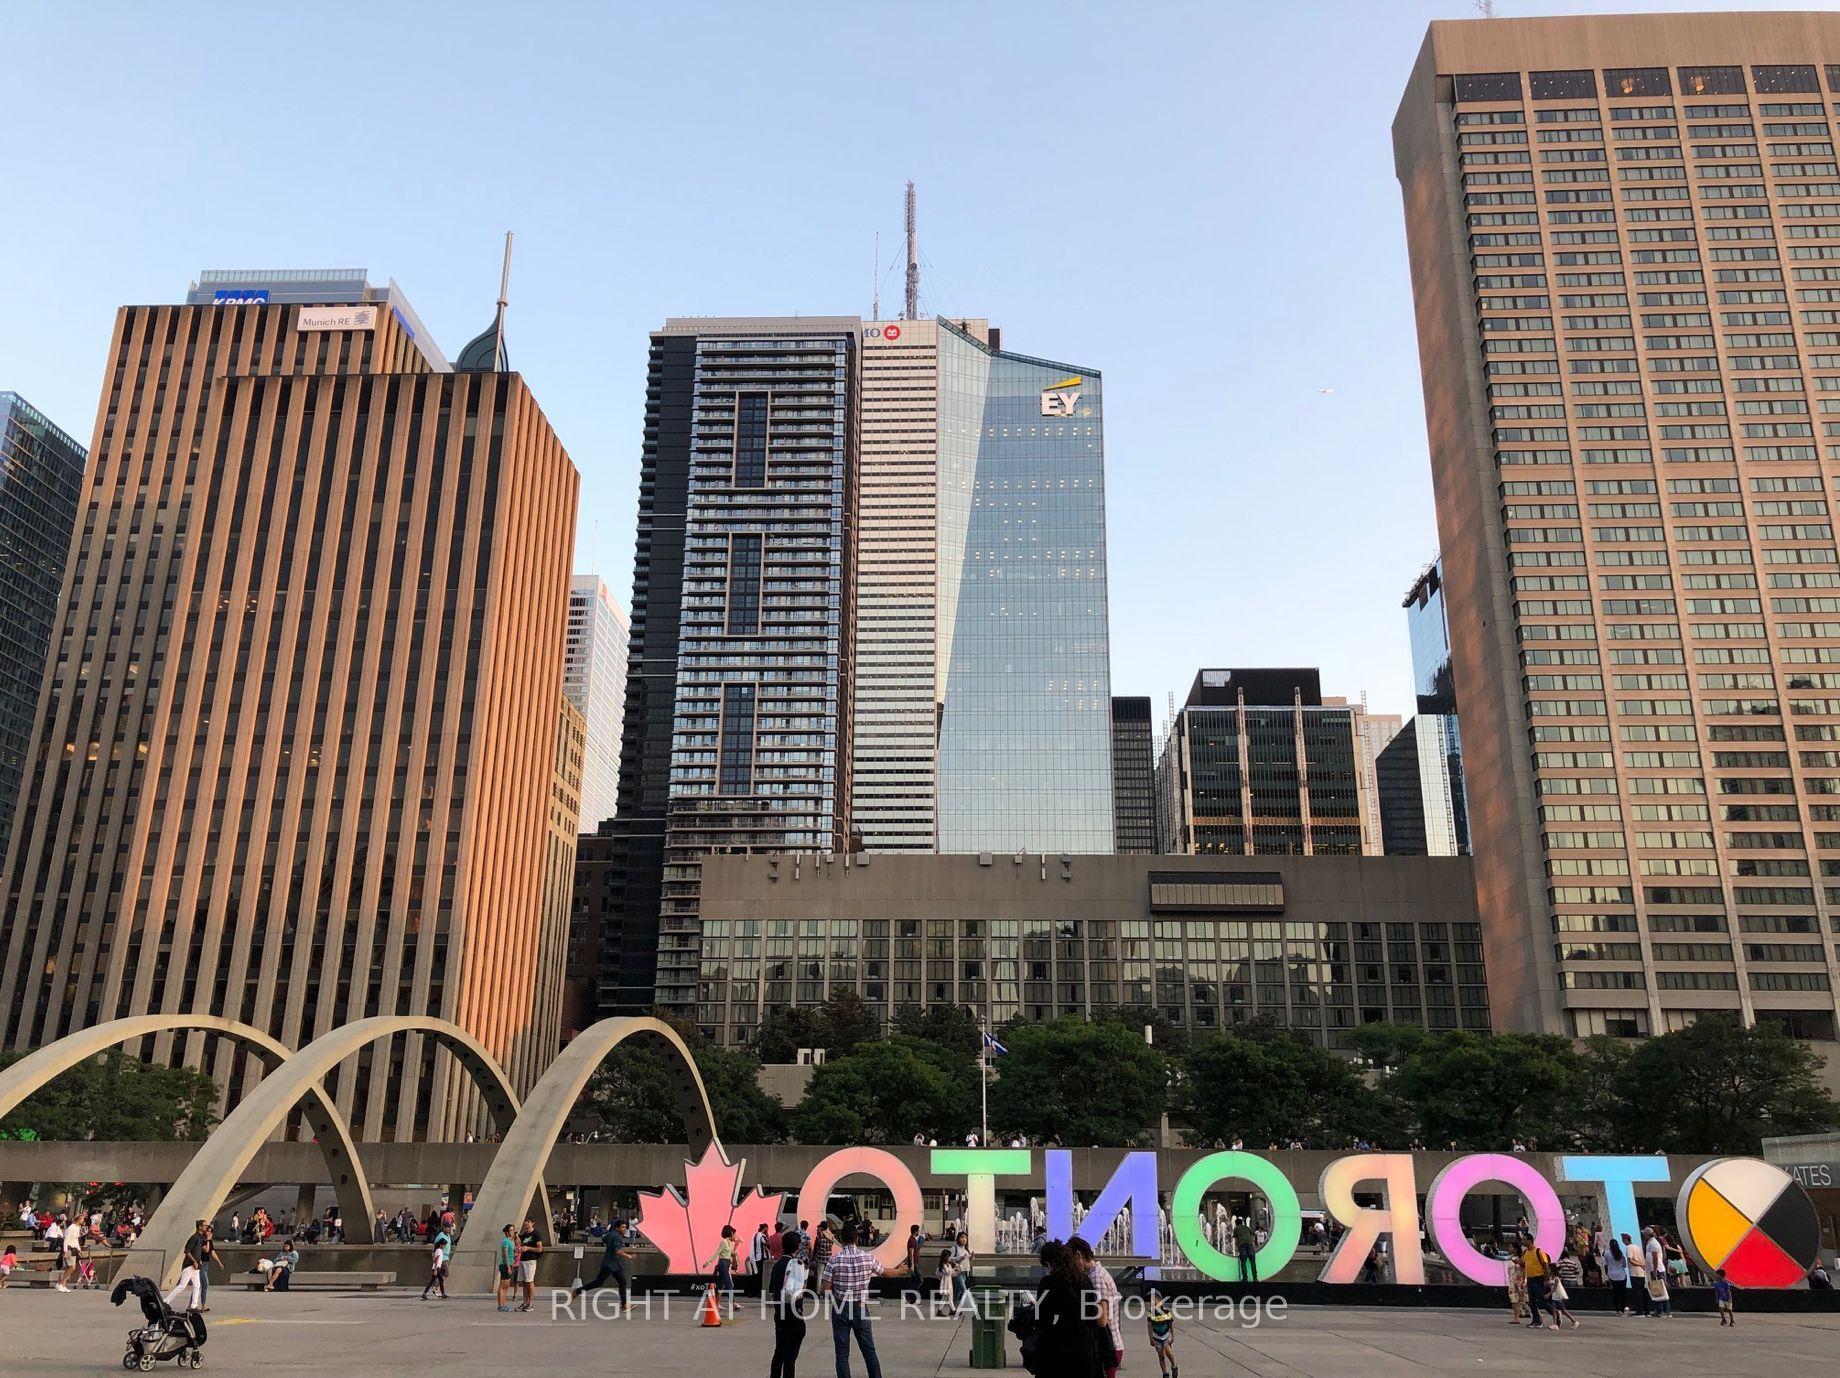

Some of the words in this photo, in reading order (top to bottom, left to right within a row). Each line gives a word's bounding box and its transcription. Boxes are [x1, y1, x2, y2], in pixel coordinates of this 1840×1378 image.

[303, 318, 335, 326] Munich
[337, 318, 350, 326] RE
[1041, 391, 1081, 415] EY
[1786, 1165, 1831, 1186] ATES
